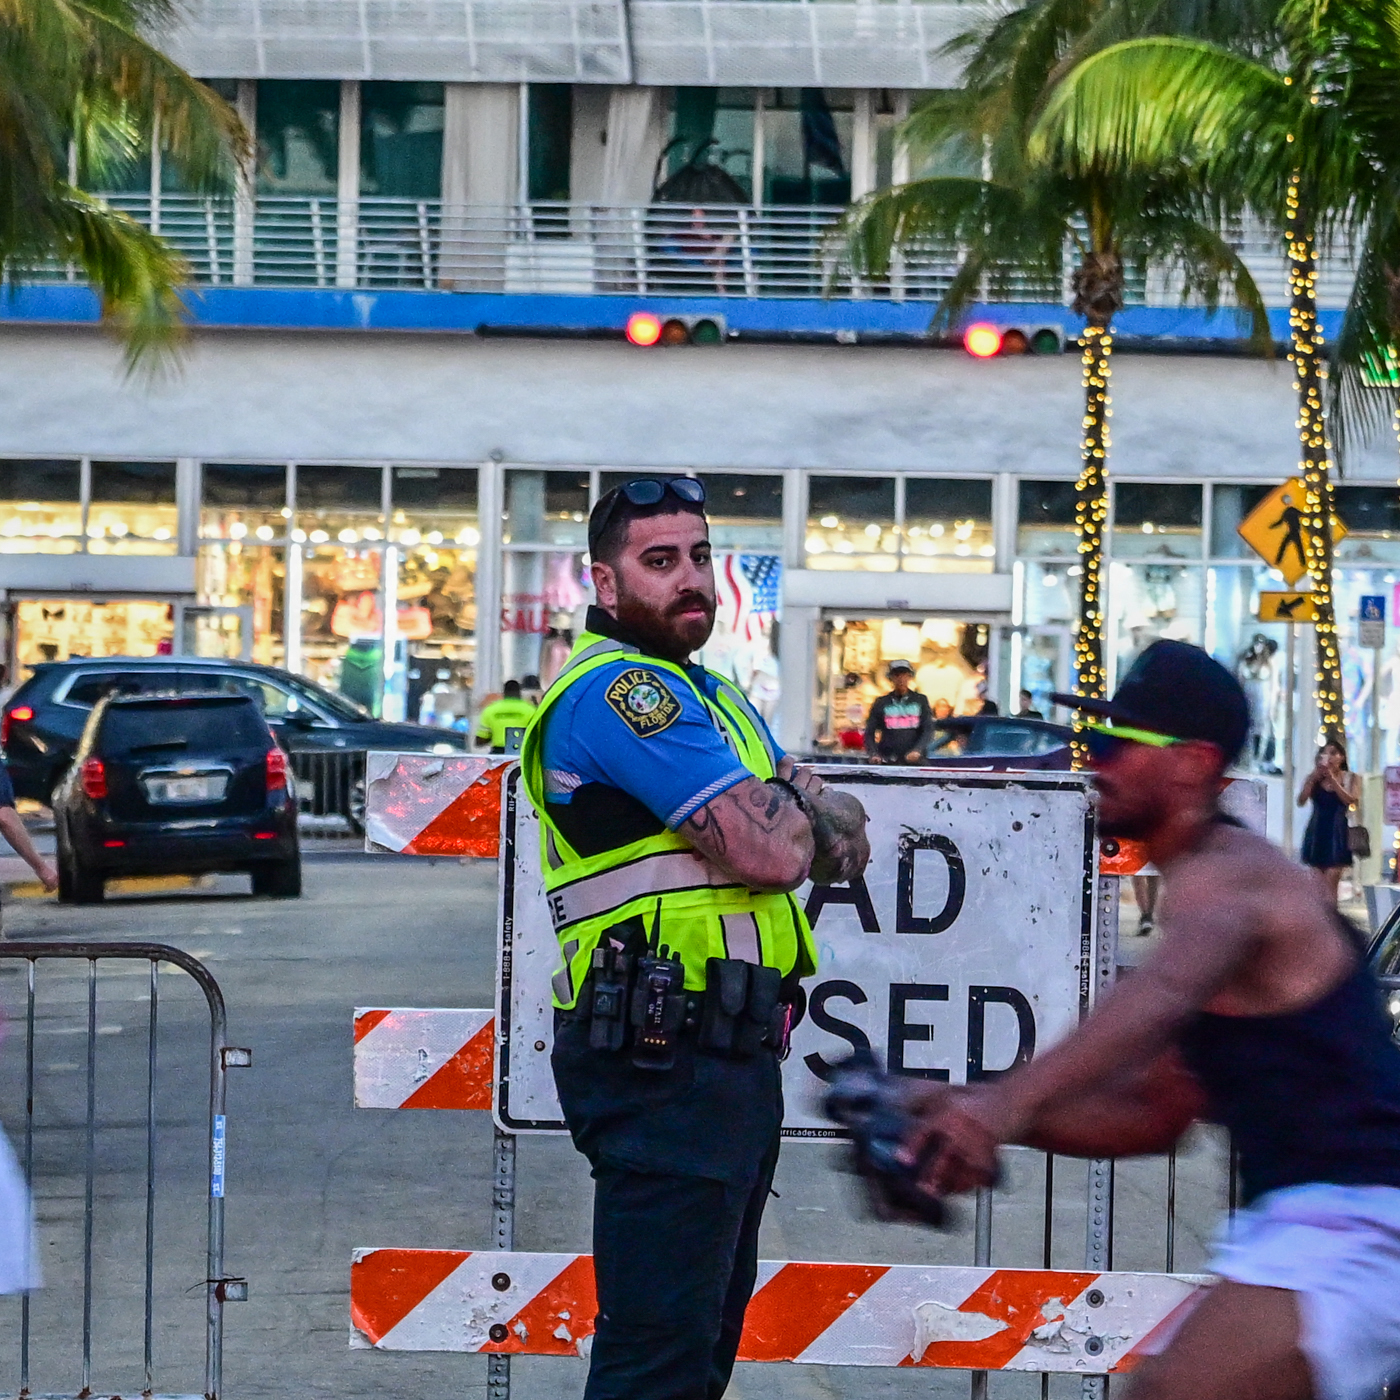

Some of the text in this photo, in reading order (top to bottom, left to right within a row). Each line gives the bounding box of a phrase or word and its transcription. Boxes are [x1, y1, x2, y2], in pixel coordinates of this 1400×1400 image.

[610, 670, 652, 702] POLICE
[640, 703, 676, 729] FLORIDA
[804, 833, 966, 934] AD
[803, 979, 1036, 1084] SED
